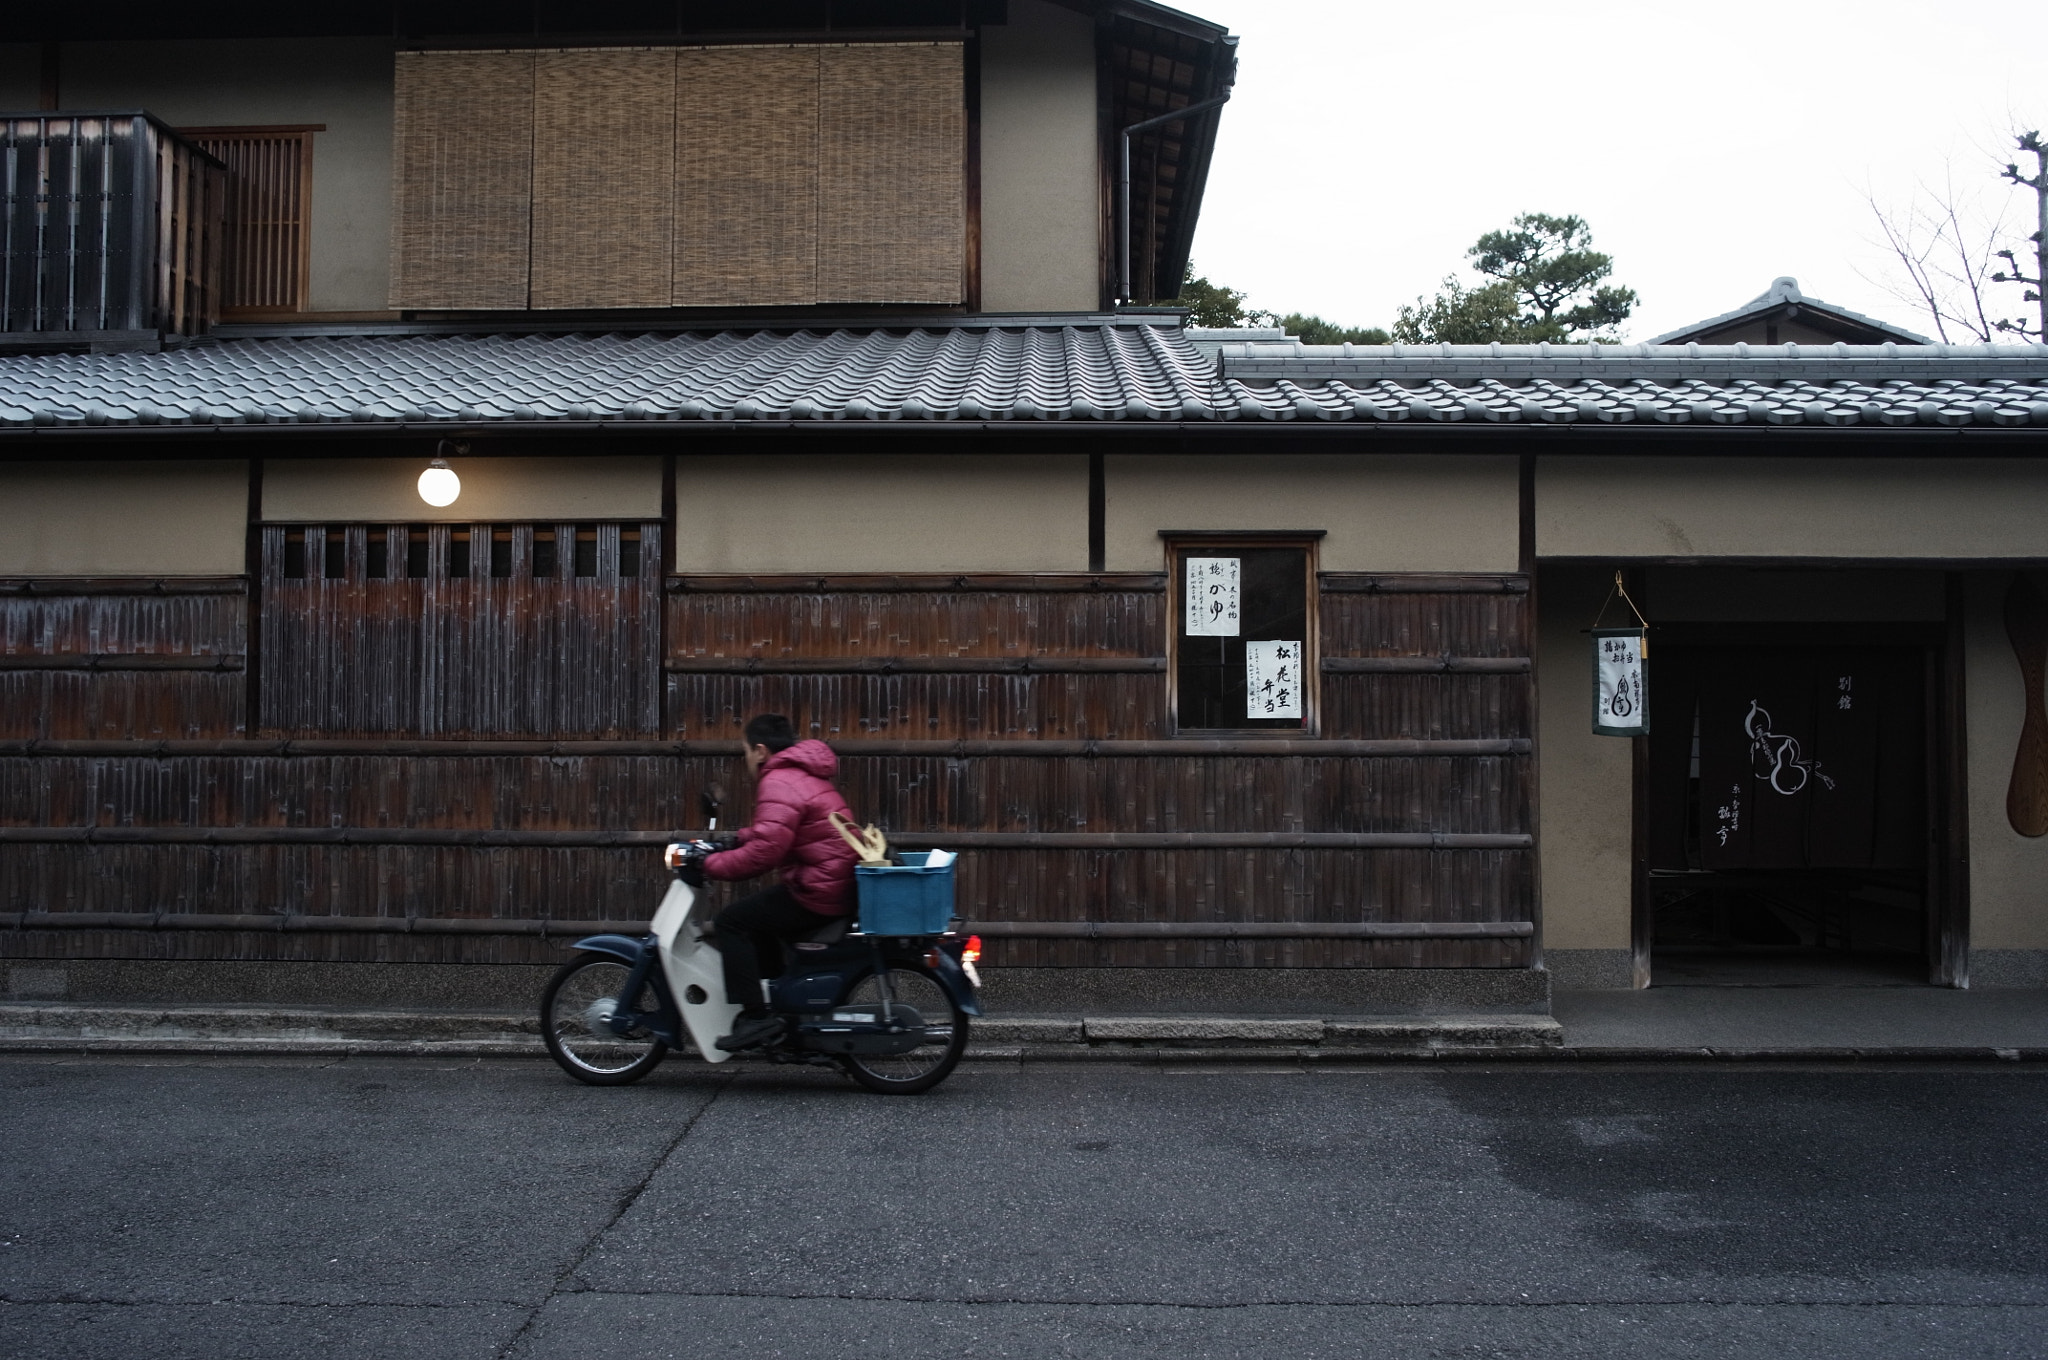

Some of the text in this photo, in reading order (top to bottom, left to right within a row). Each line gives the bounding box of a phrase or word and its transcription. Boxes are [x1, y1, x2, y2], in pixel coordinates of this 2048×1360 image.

[1612, 651, 1634, 665] お弁当
[1276, 645, 1291, 708] 松花堂
[1837, 675, 1852, 710] 別館
[1261, 678, 1274, 713] 弁当
